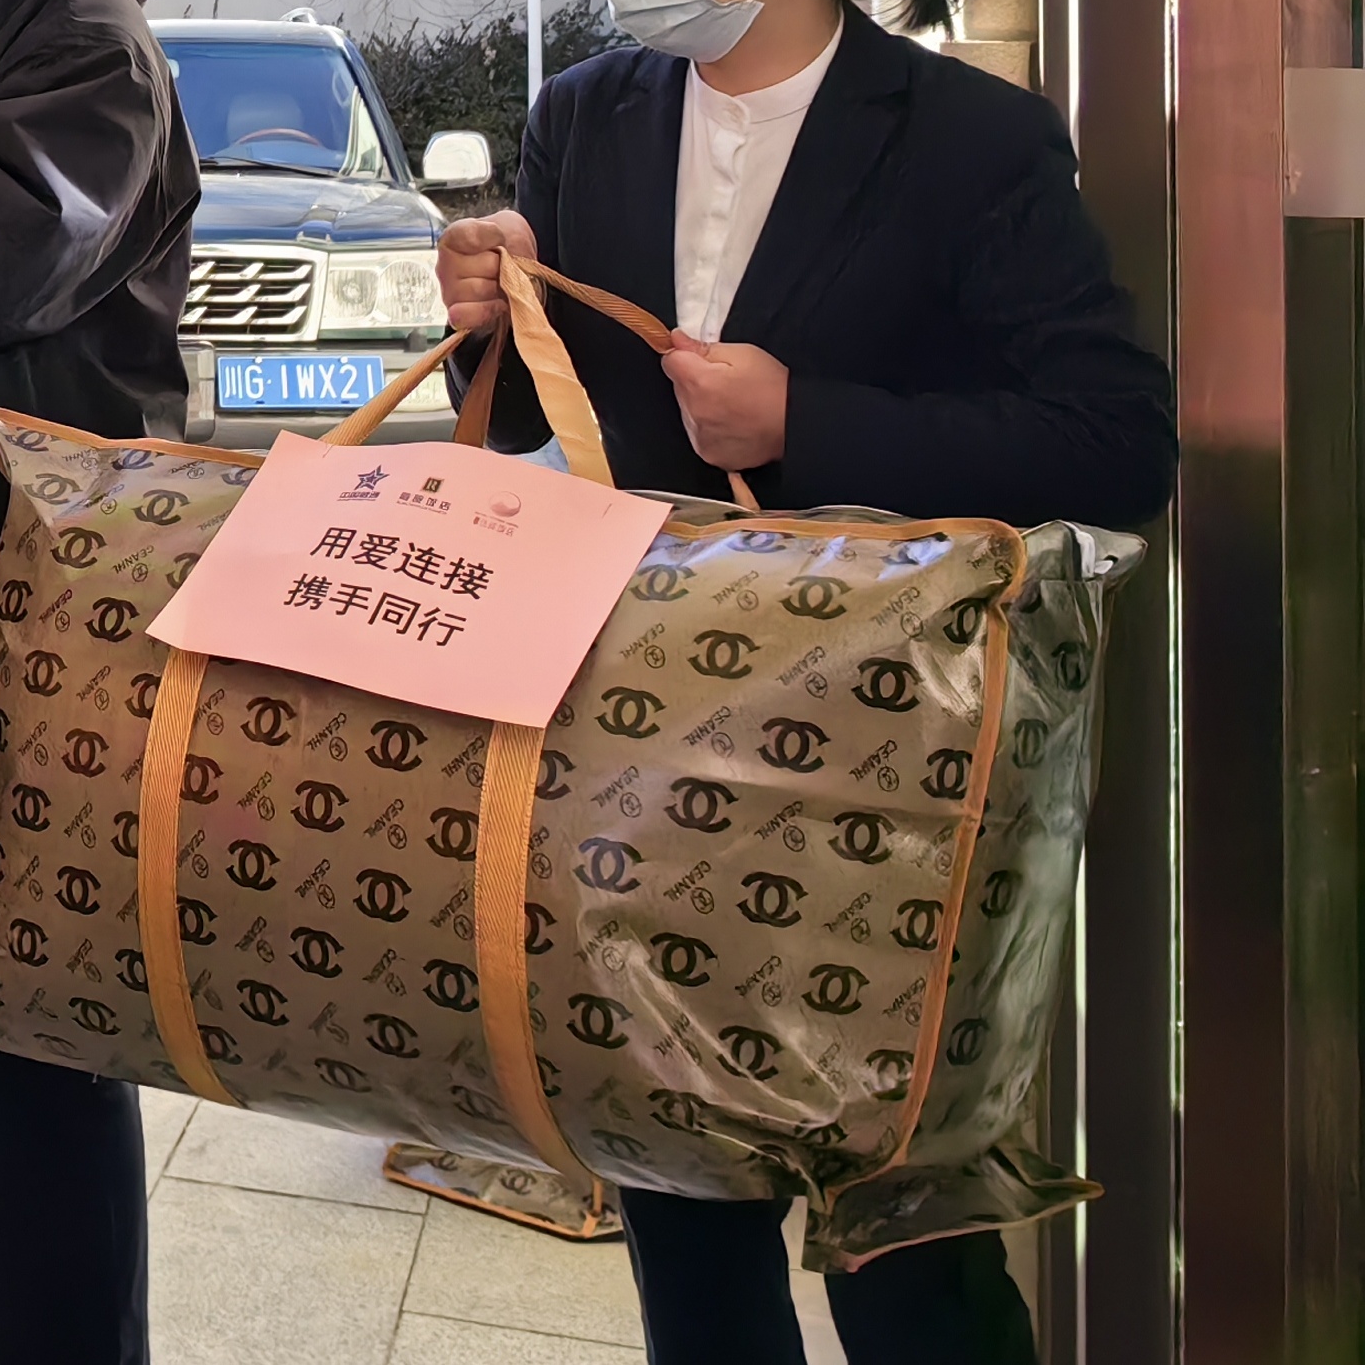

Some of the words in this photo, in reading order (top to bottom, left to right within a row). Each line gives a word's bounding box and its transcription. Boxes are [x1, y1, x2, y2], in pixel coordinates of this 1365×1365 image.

[309, 526, 495, 600] 用爱连接
[283, 572, 467, 647] 携手同行
